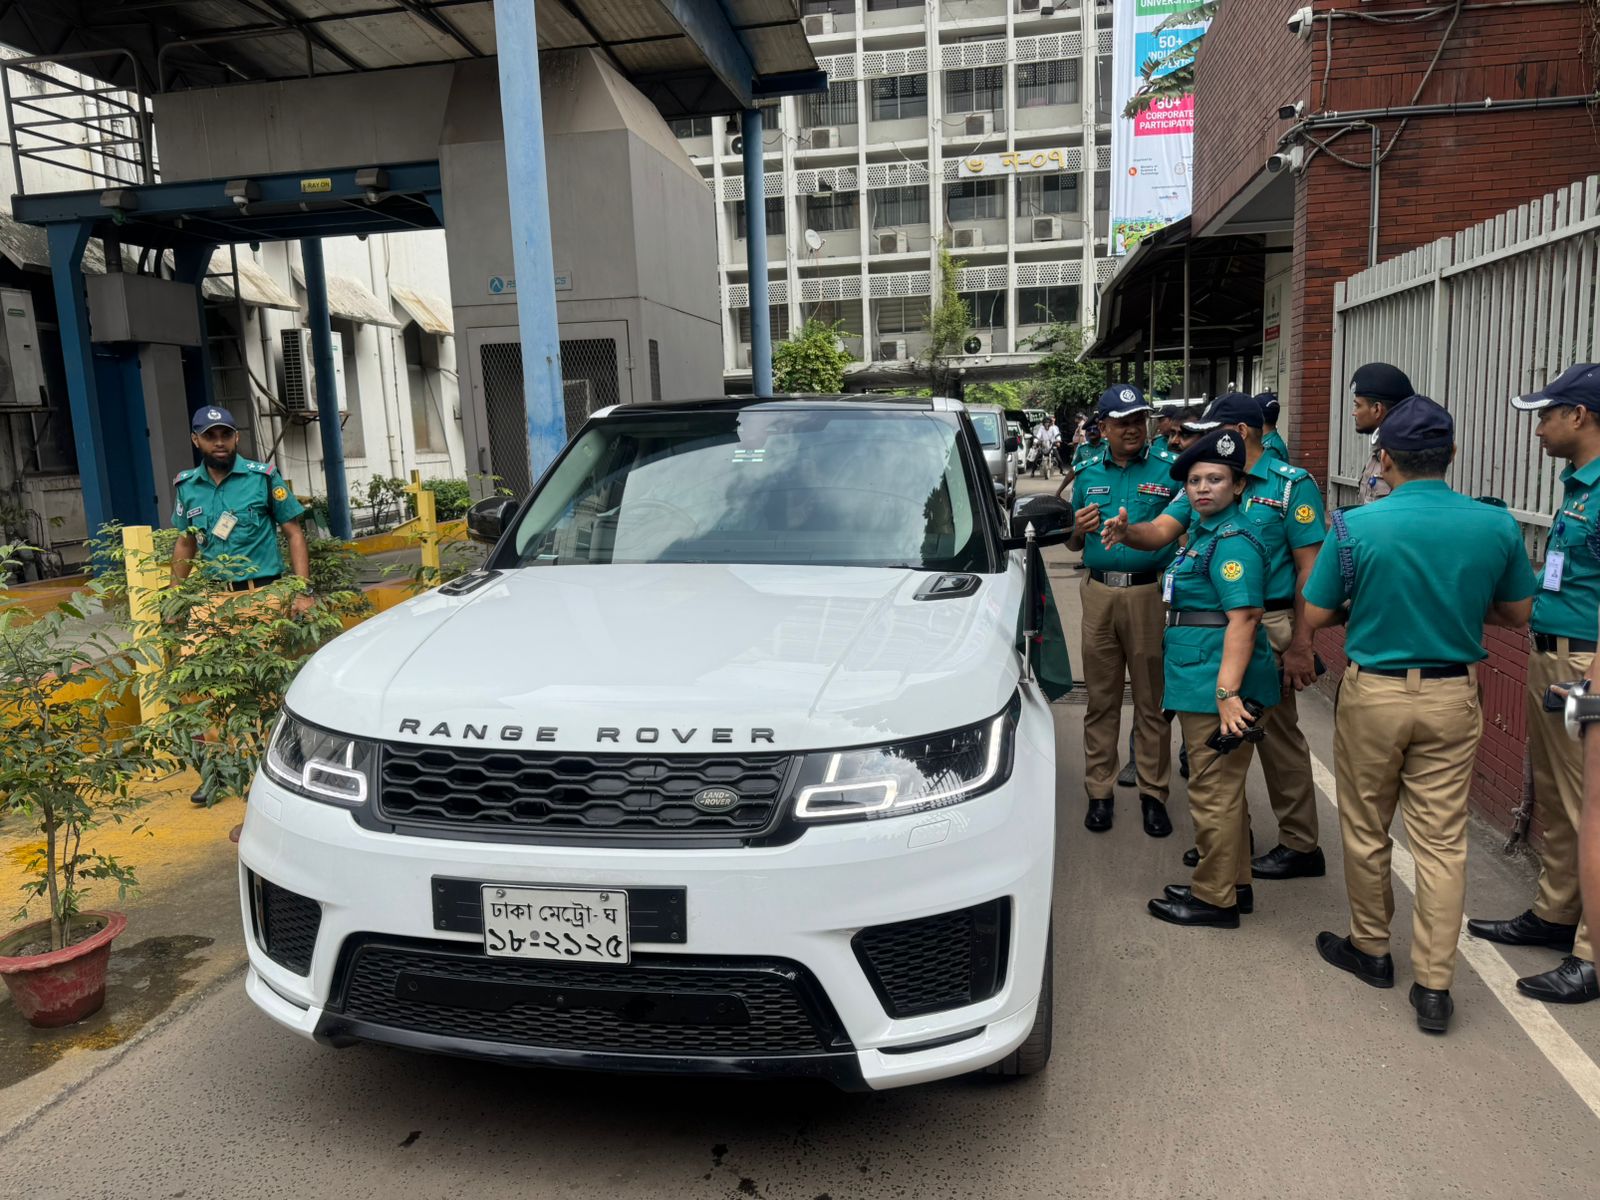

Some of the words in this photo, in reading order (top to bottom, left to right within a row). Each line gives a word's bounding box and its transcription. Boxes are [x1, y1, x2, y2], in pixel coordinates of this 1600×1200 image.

[1159, 35, 1183, 49] 50+
[1157, 97, 1182, 110] 50+
[1145, 109, 1194, 120] CORPORATE
[1139, 119, 1194, 130] PARTICIPATIO
[398, 717, 559, 743] RANGE
[596, 726, 776, 745] ROVER
[490, 901, 533, 921] ঢাকা
[603, 907, 618, 925] ঘ
[487, 927, 624, 958] ১৮-২১২৫
